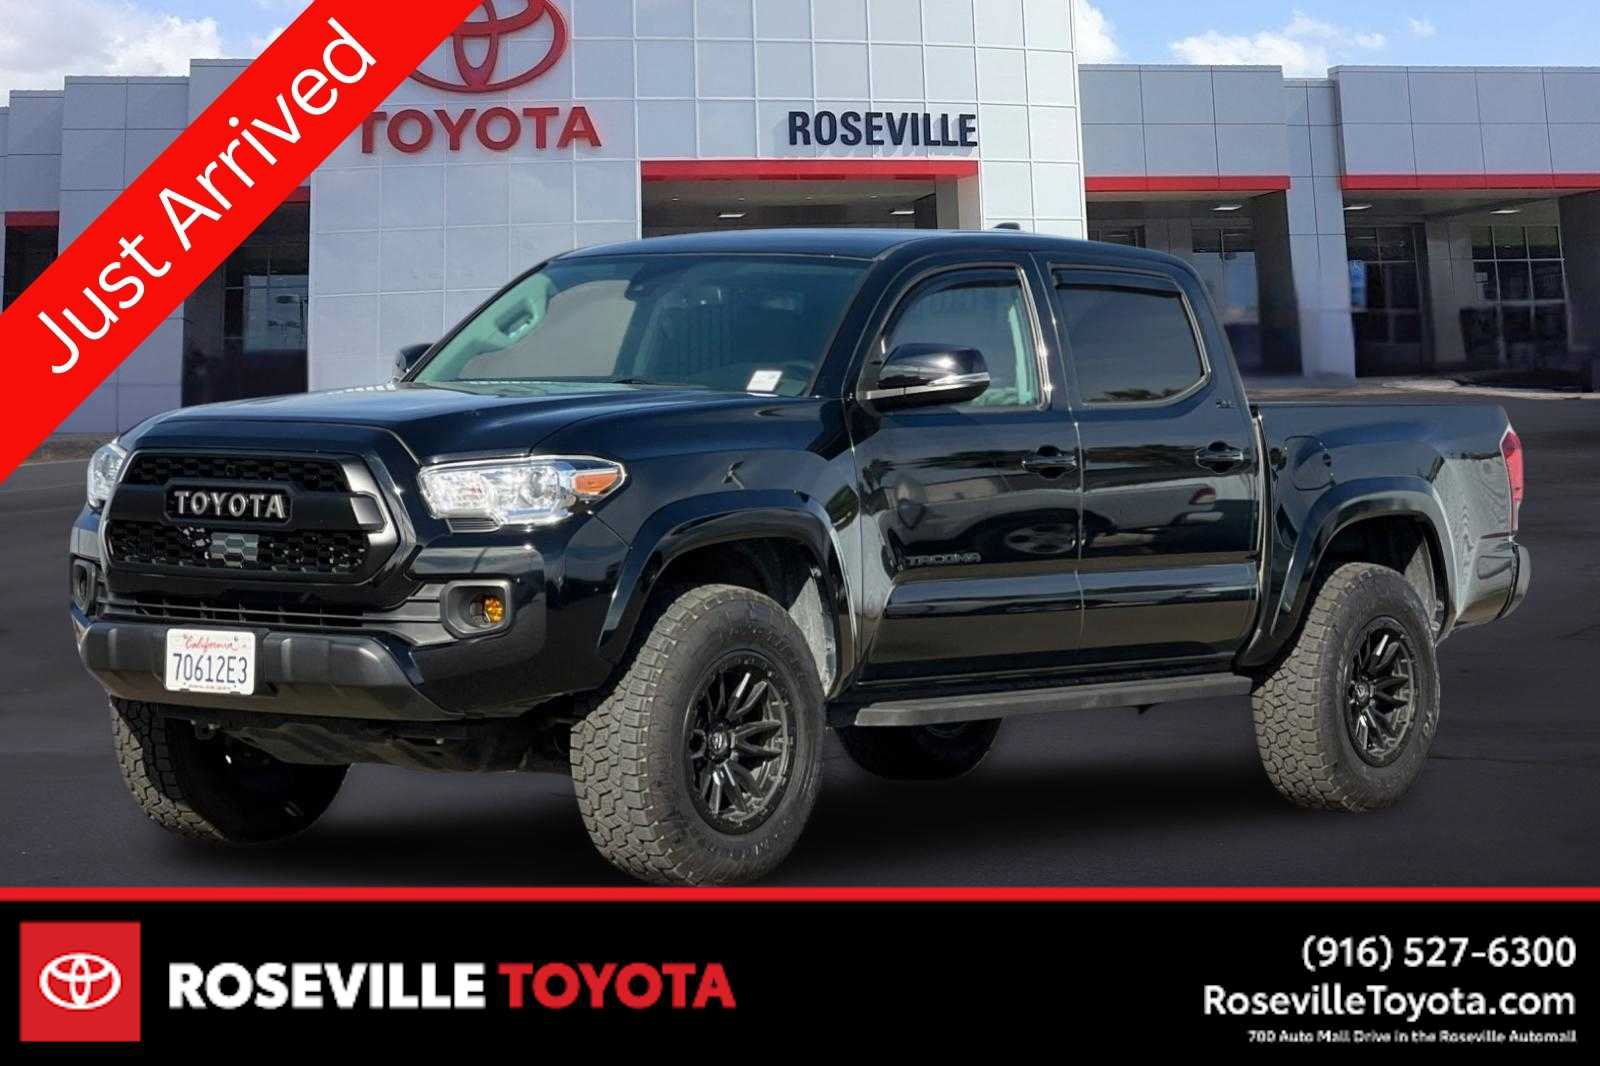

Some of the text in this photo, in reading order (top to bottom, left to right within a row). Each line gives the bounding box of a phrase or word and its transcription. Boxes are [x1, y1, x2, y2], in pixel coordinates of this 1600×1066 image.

[361, 106, 602, 154] TOYOTA
[788, 111, 978, 147] ROSEVILLE
[174, 490, 286, 519] TOYOTA
[173, 653, 248, 684] 70612E3
